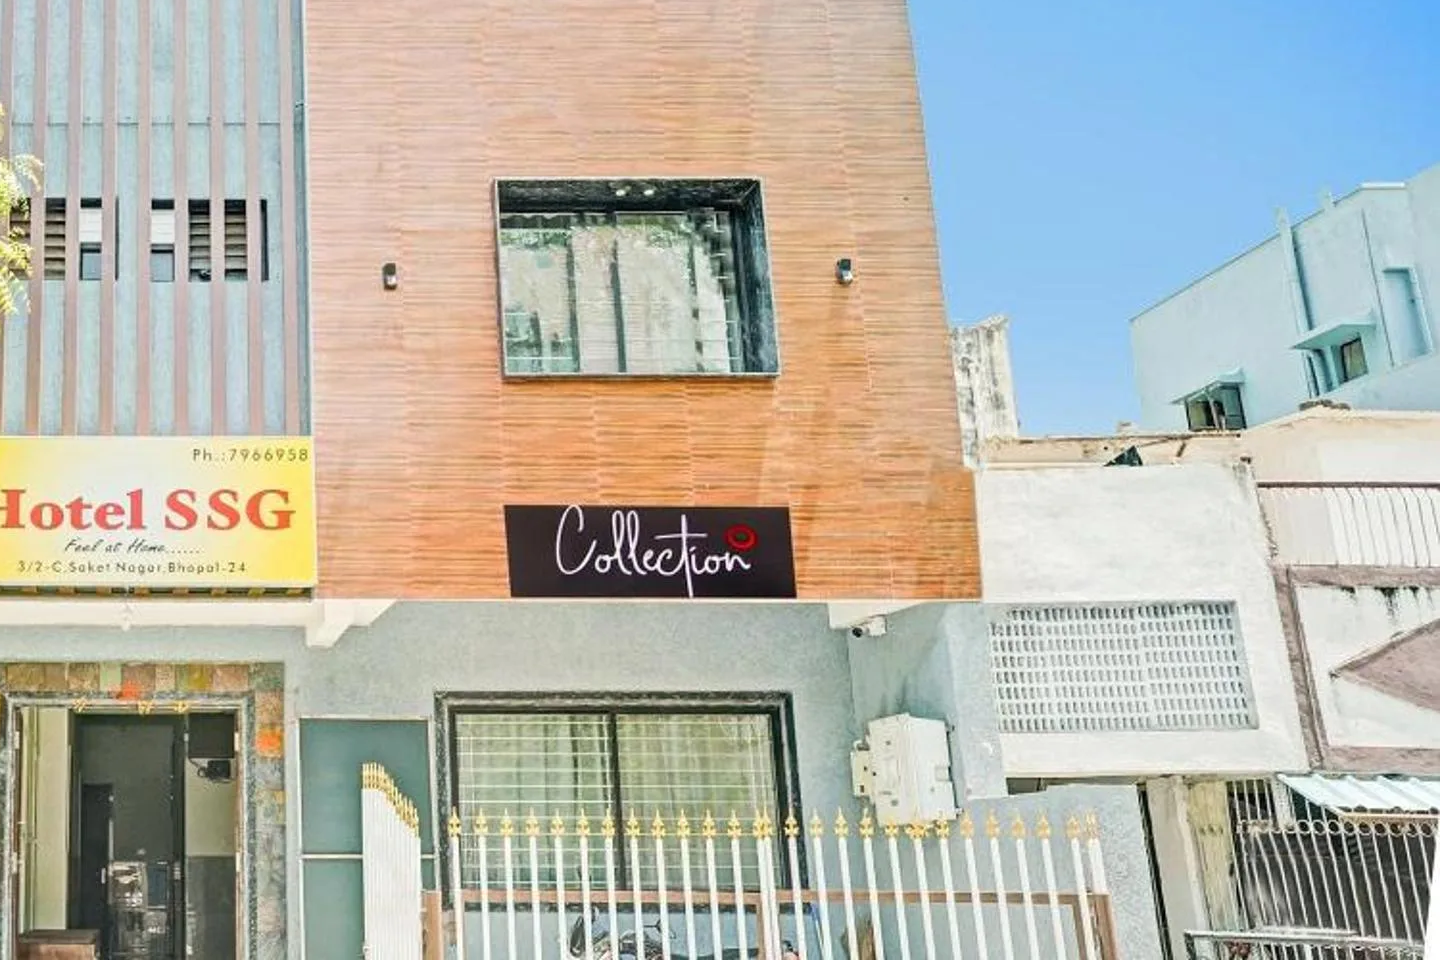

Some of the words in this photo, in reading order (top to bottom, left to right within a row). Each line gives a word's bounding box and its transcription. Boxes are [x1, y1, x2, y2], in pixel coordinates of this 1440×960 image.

[164, 488, 297, 531] SSG
[64, 537, 103, 553] Feel
[105, 541, 123, 553] at
[556, 504, 752, 597] Collection
